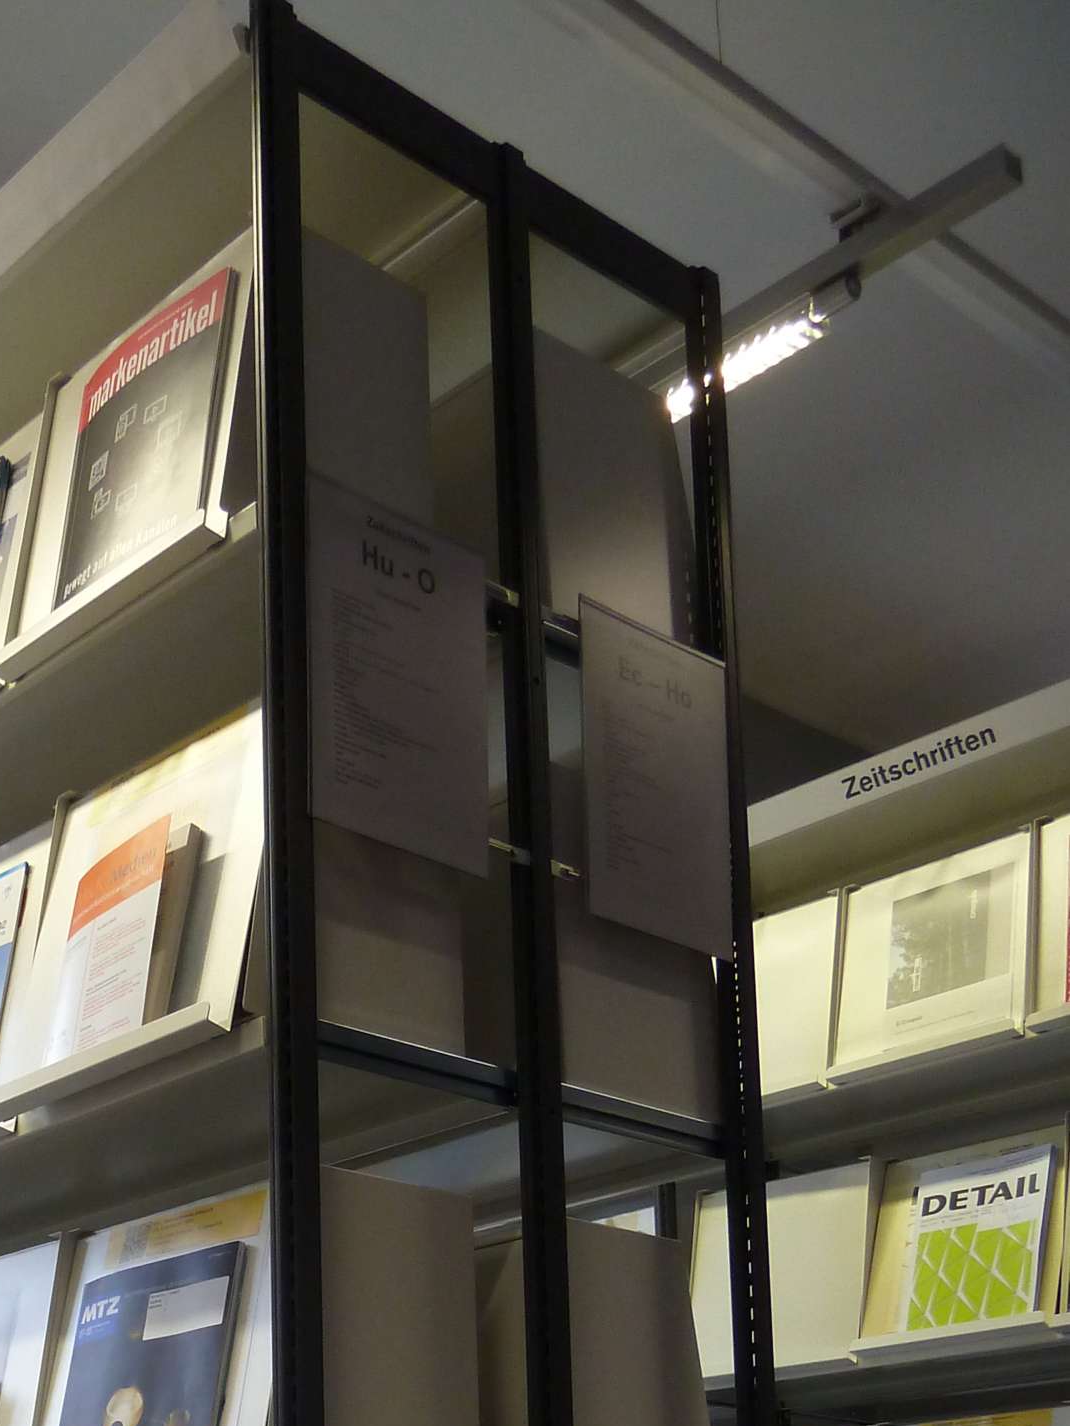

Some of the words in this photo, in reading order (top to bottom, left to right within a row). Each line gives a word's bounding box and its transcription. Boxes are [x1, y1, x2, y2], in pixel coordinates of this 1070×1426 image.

[87, 289, 218, 424] markenartikel
[361, 538, 394, 579] Hu
[841, 727, 997, 800] Zeitschriften
[921, 1172, 1041, 1218] DETAIL
[81, 1295, 121, 1325] MTZ
